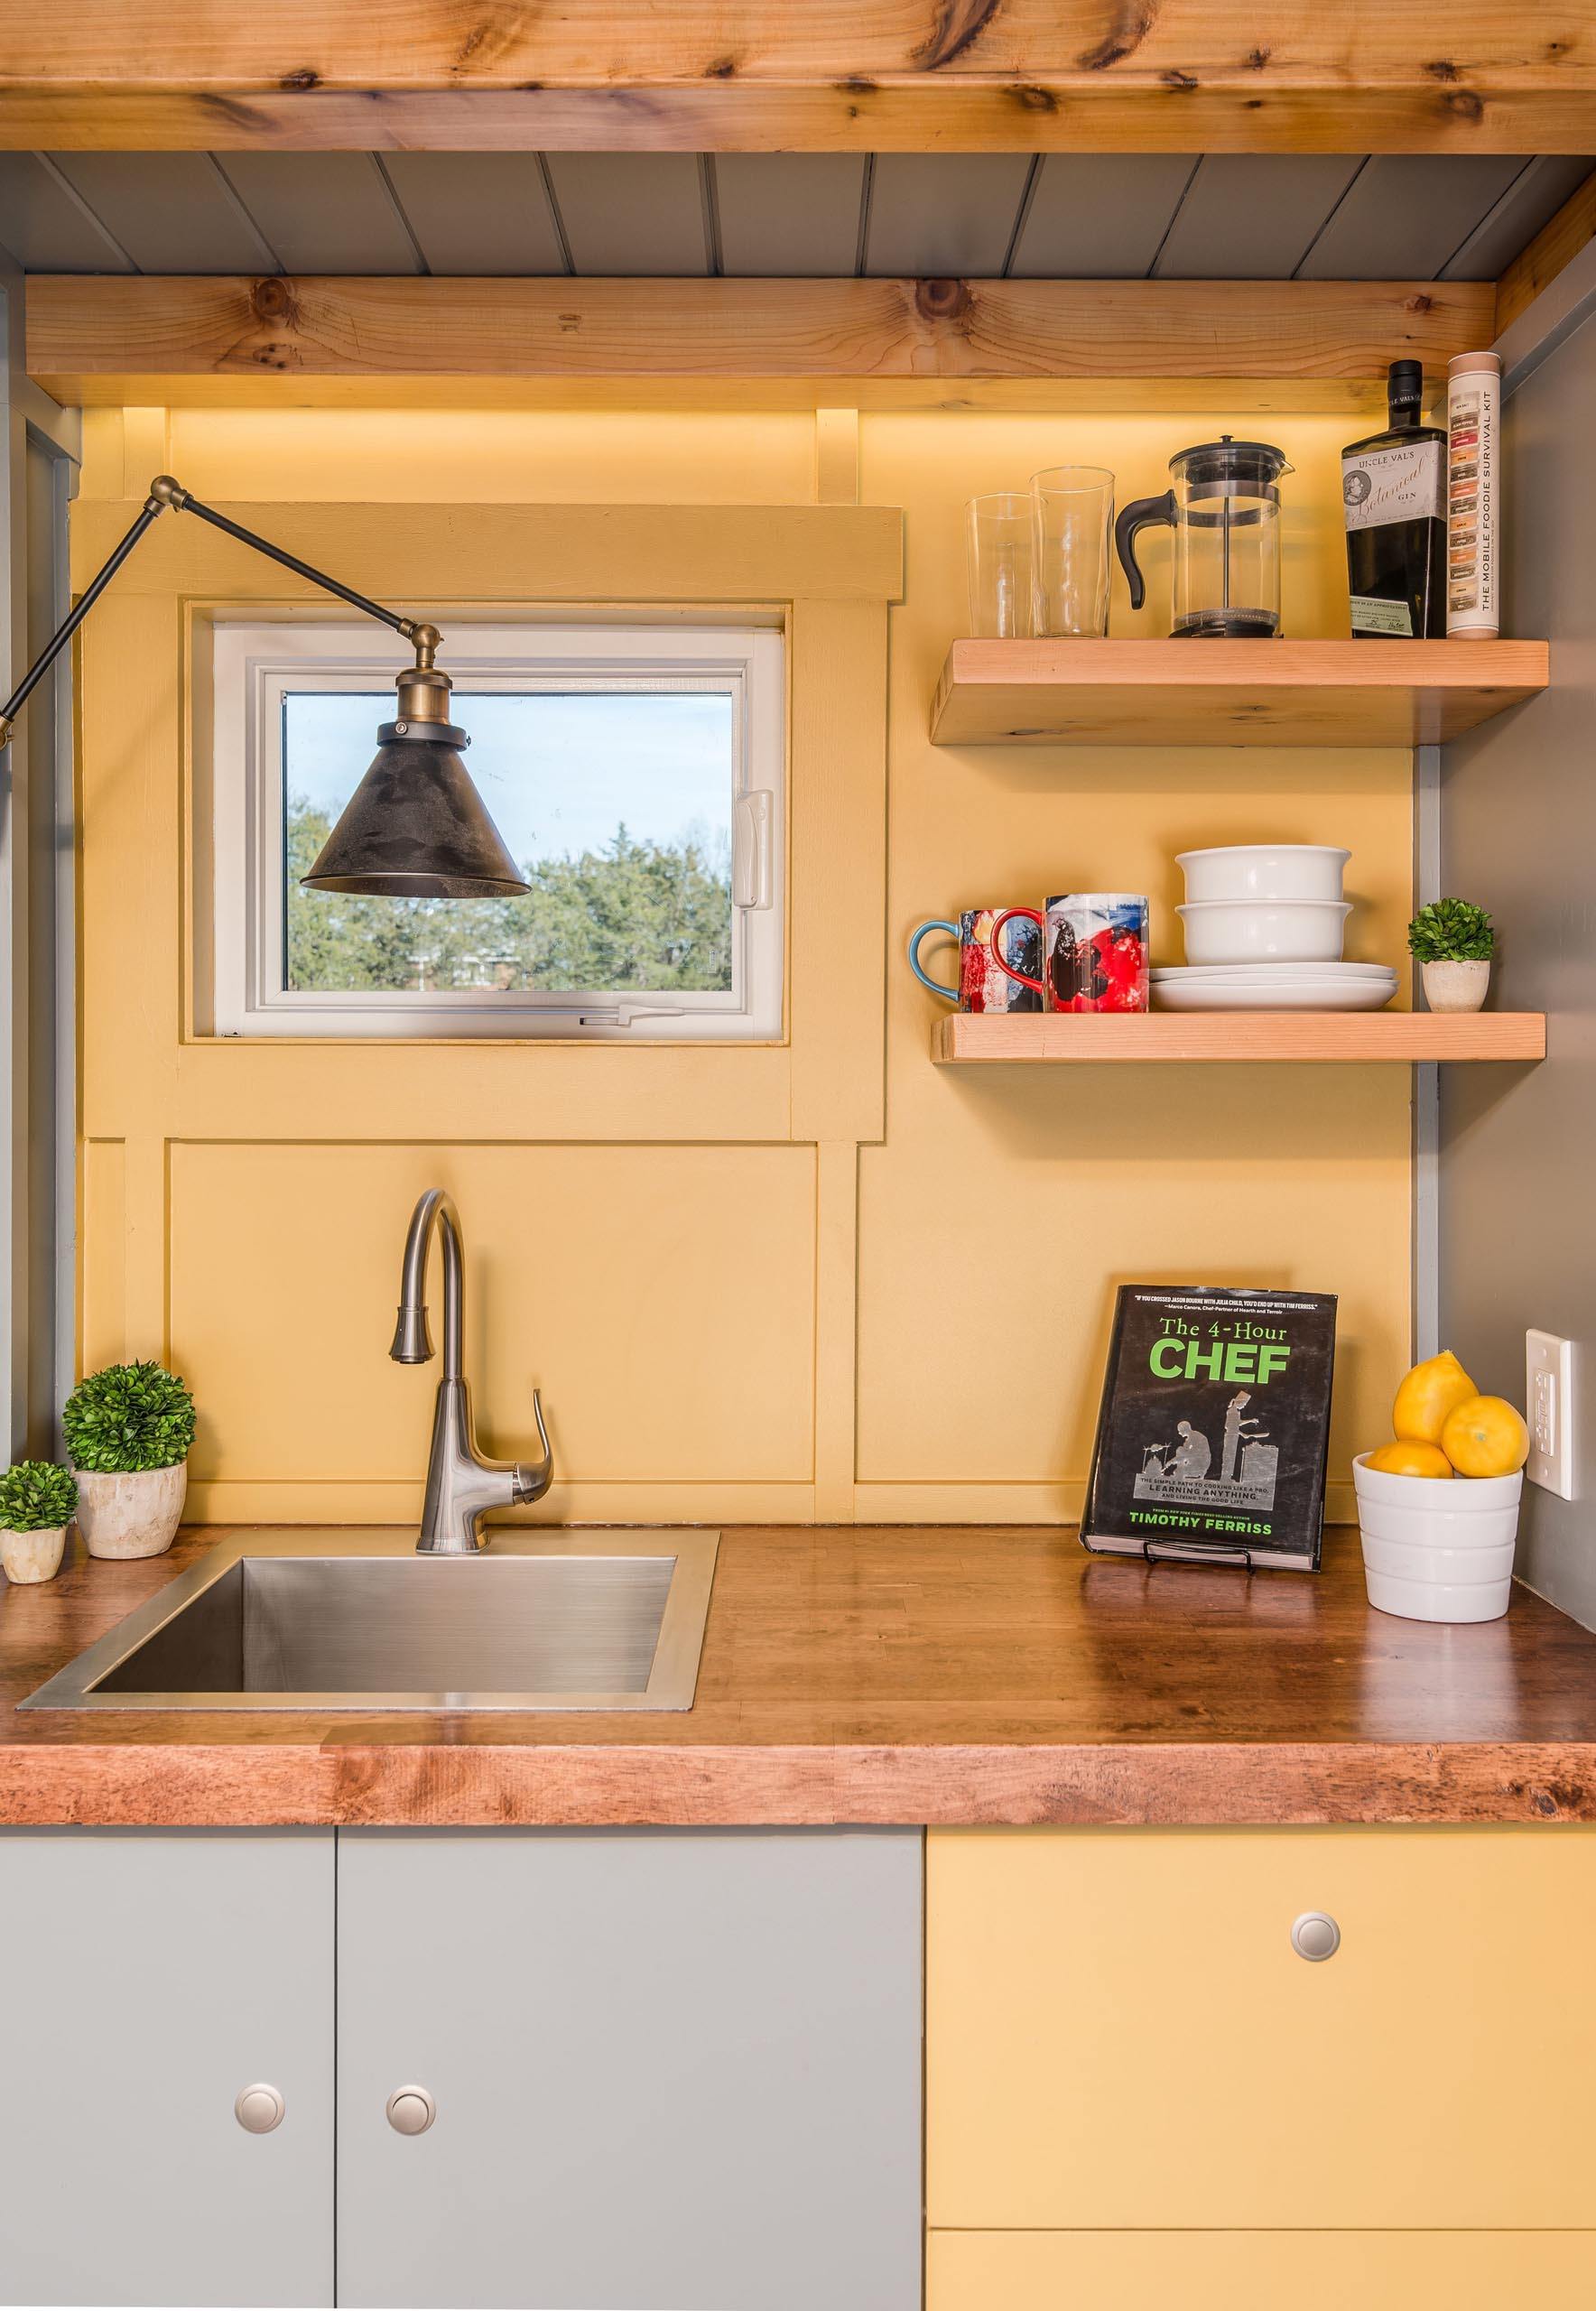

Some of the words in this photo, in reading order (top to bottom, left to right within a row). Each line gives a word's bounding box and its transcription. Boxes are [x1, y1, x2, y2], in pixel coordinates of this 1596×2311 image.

[1359, 456, 1387, 469] UNCLE
[1391, 451, 1415, 461] VAL'S
[1352, 457, 1424, 524] Botanical
[1397, 492, 1416, 501] GIN
[1482, 534, 1490, 581] MOBILE
[1160, 1317, 1200, 1336] The
[1208, 1321, 1287, 1341] 4-Hour
[1149, 1338, 1291, 1384] CHEF
[1149, 1484, 1201, 1495] LEARNING
[1203, 1490, 1258, 1500] ANYTHING,
[1129, 1511, 1201, 1527] TIMOTHY
[1205, 1518, 1272, 1536] FERRISS
